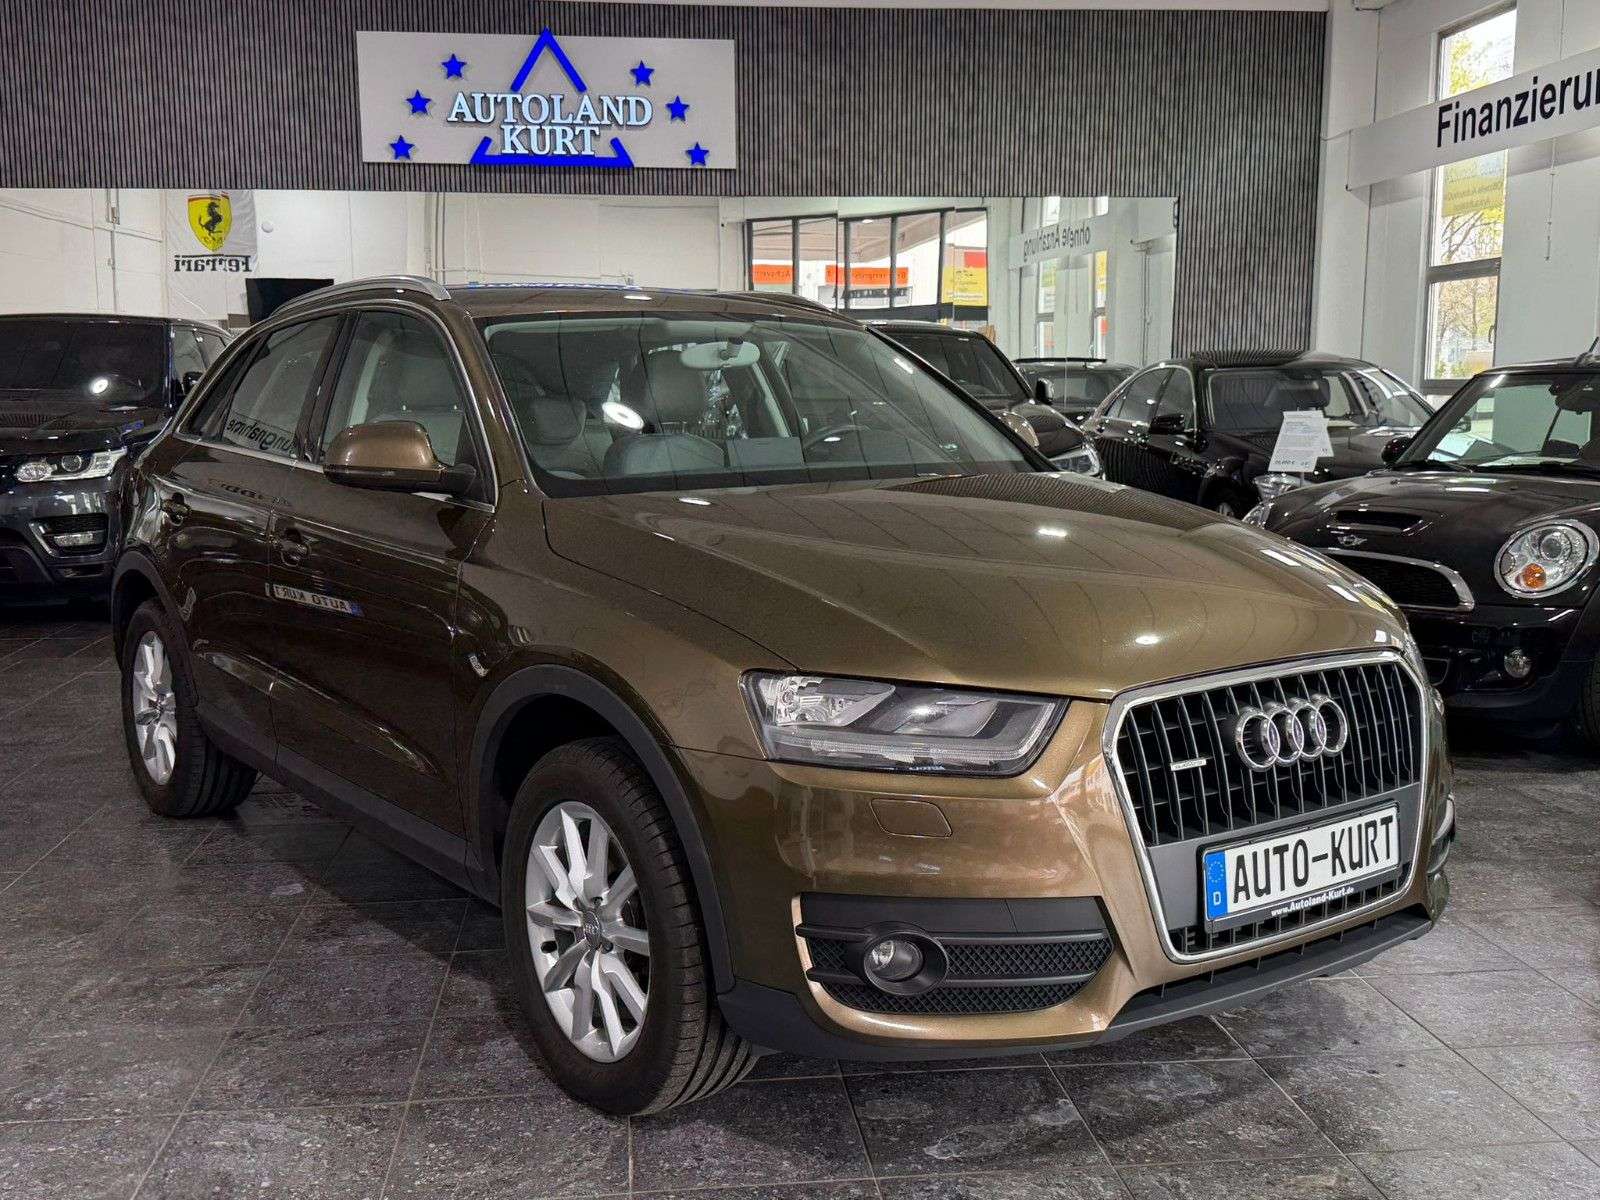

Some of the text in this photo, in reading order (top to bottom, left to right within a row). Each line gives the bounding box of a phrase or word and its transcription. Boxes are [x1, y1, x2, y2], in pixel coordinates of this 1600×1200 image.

[447, 91, 654, 127] AUTOLAND
[1437, 68, 1600, 148] Finanzieru
[500, 124, 600, 156] KURT
[1232, 814, 1394, 904] AUTO-KURT
[1213, 891, 1222, 905] D
[1271, 886, 1355, 917] www.Autoland-Kurt.de
